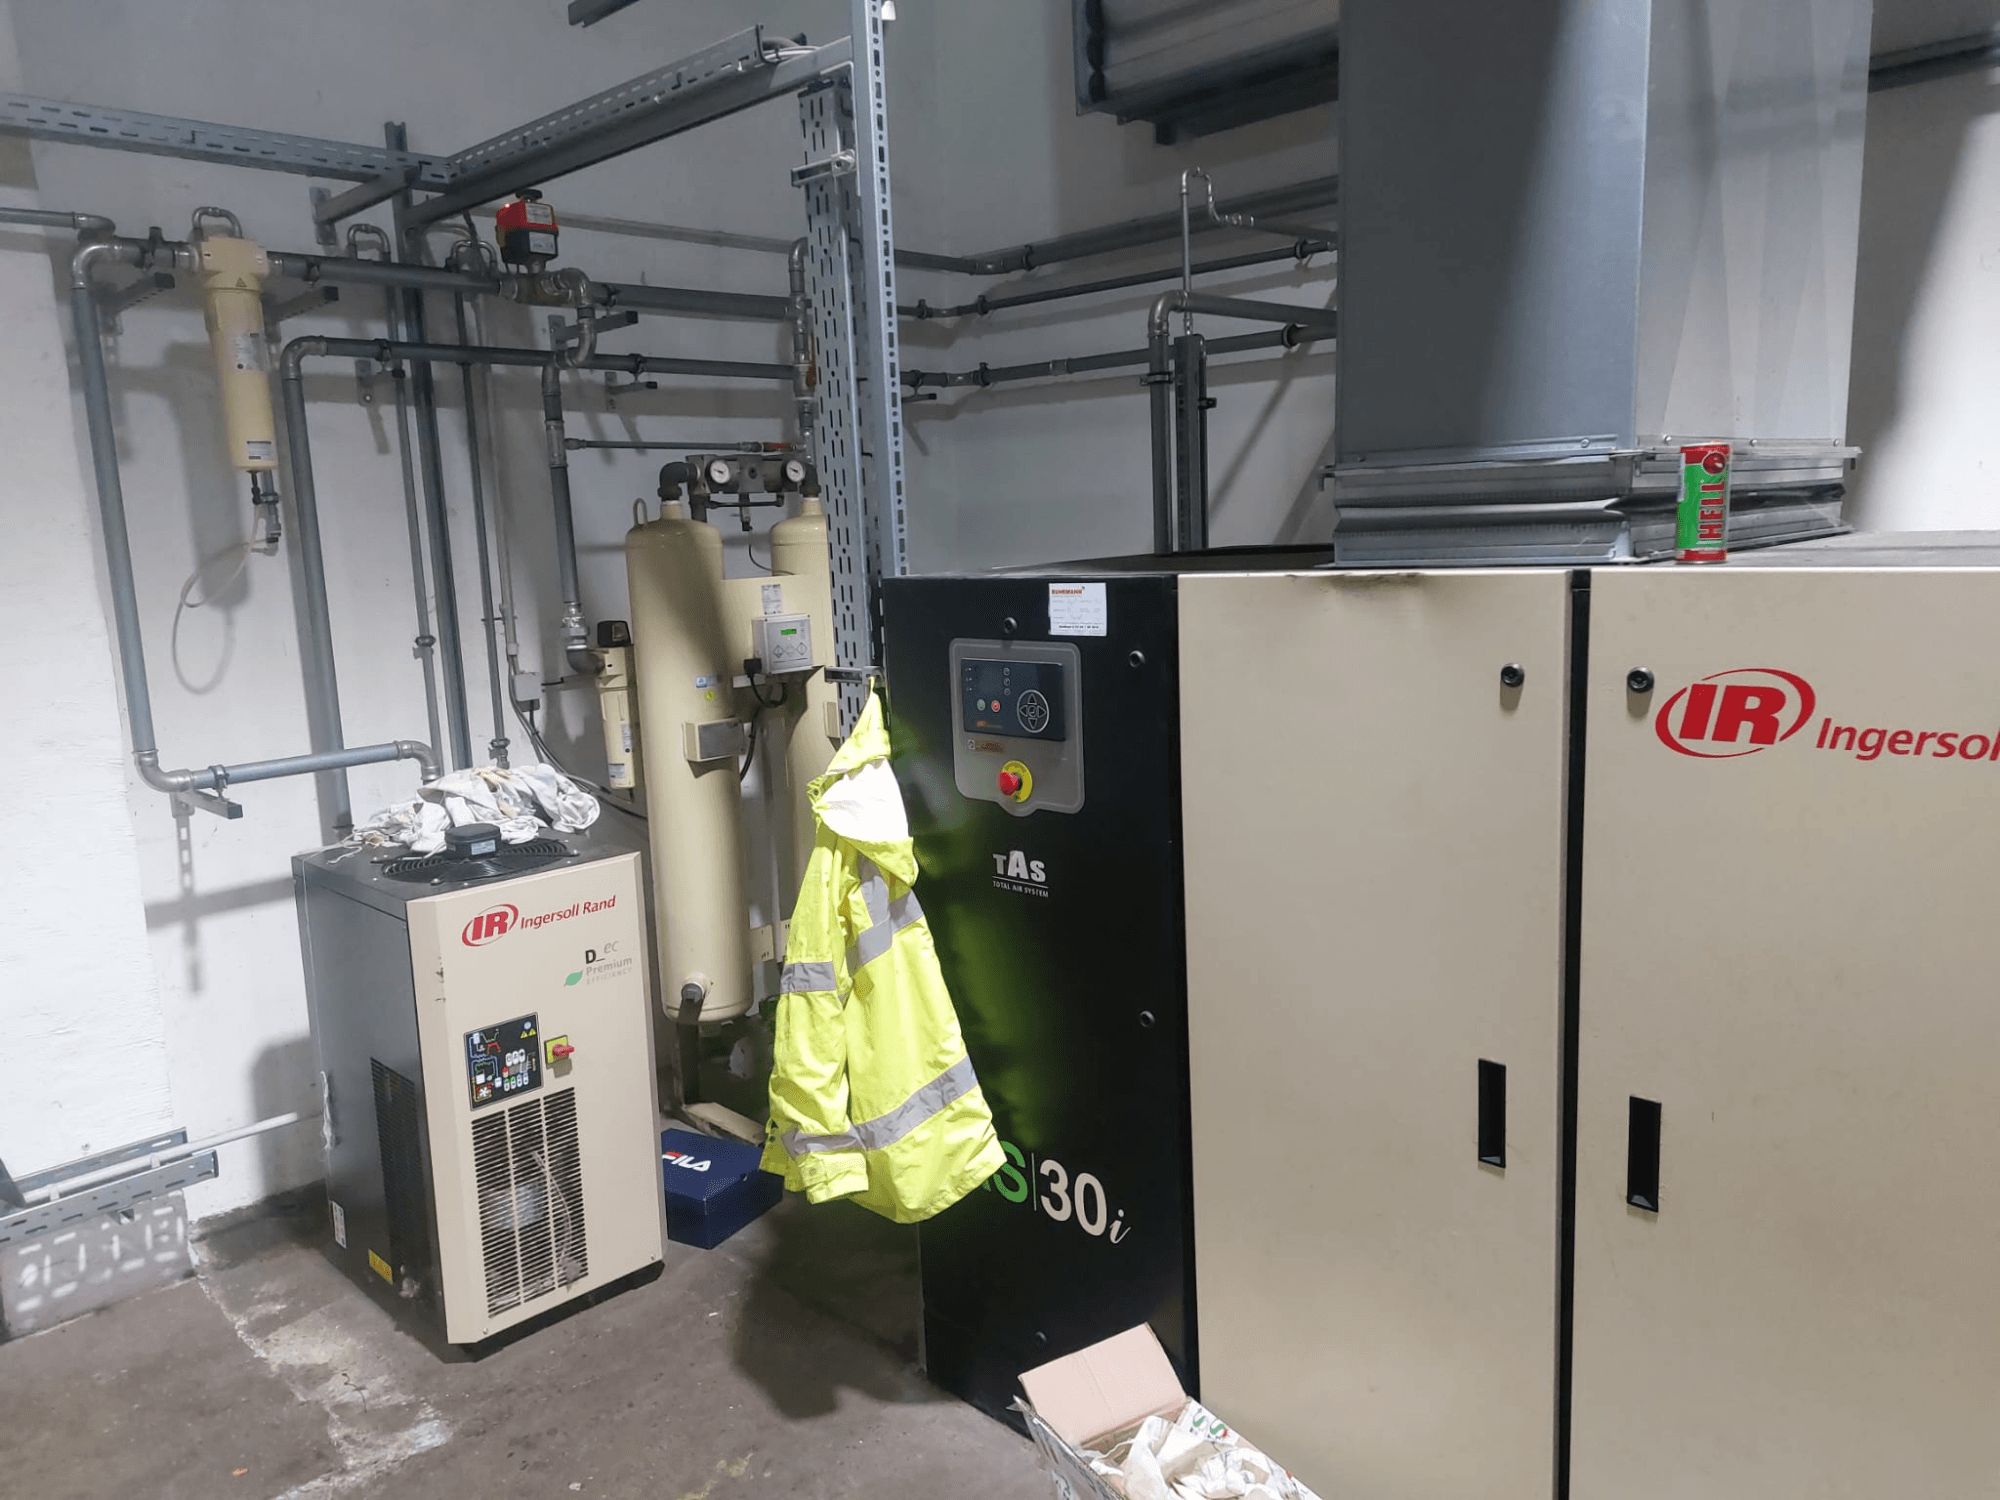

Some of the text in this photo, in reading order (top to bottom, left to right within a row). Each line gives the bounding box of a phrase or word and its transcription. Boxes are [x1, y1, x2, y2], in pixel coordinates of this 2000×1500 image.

[1698, 481, 1725, 540] HELL
[1679, 682, 2000, 761] IR Ingersol
[992, 880, 1049, 898] TOTAL AIR SYSTEM
[471, 894, 616, 941] IR Ingersoll Rand
[586, 957, 633, 977] Premium
[662, 1150, 712, 1171] FILA
